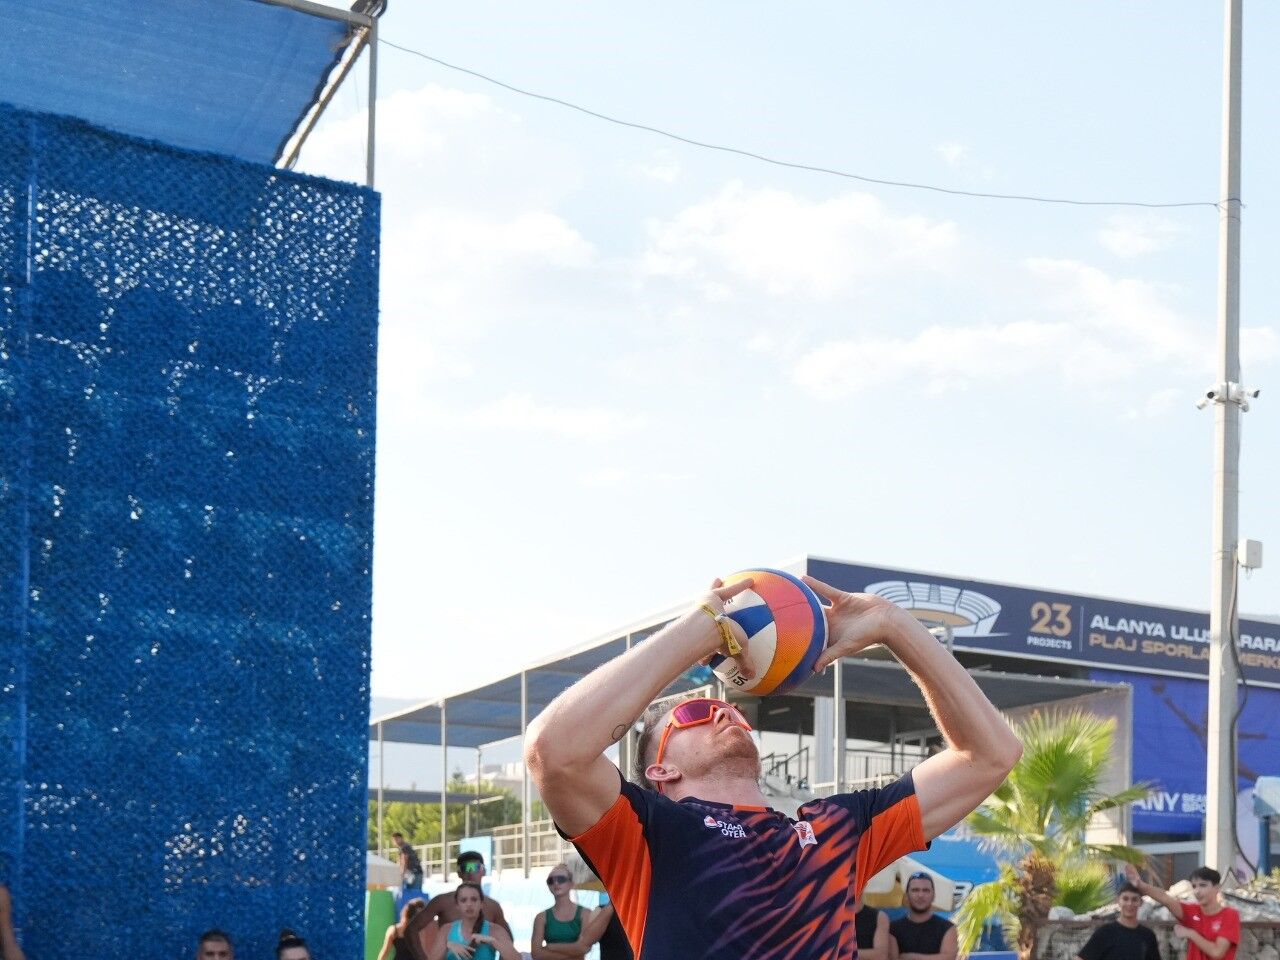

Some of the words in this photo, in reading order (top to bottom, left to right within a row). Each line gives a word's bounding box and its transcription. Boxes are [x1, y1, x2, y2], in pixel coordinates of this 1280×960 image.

[1030, 602, 1072, 637] 23
[1090, 614, 1166, 638] ALANYA
[1088, 633, 1137, 651] PLAJ
